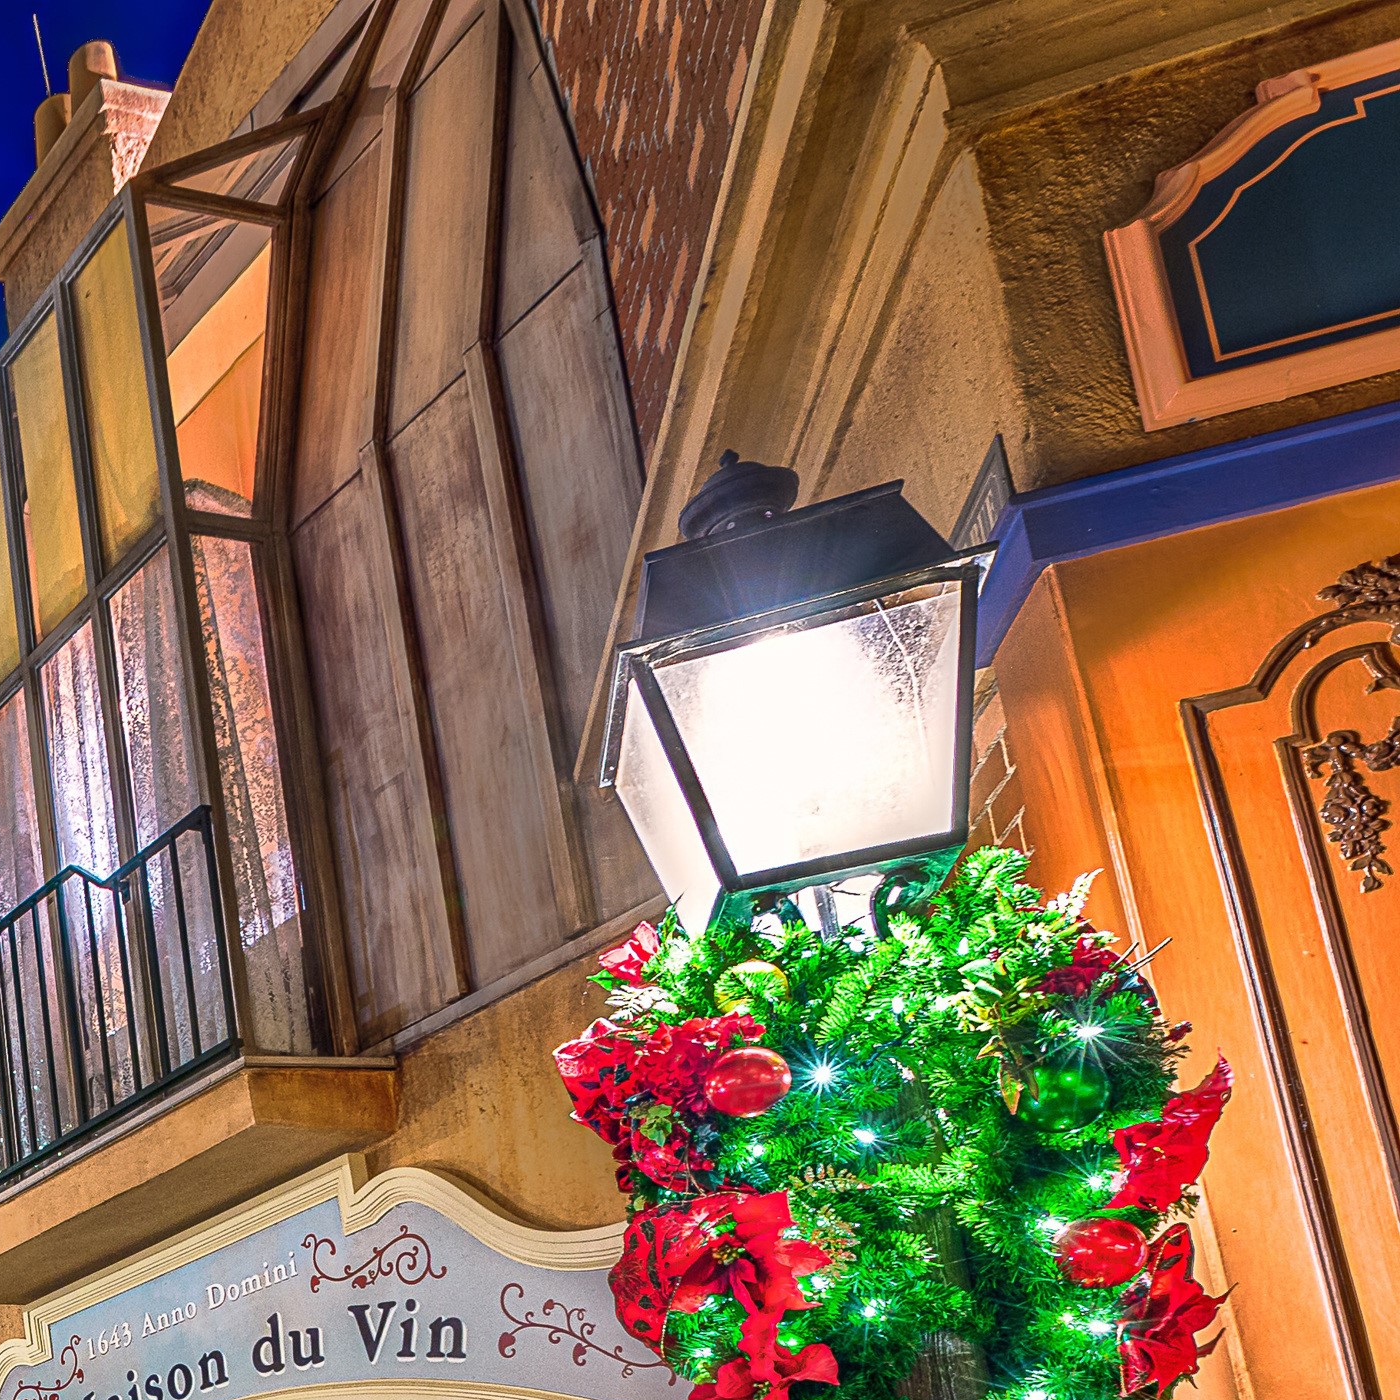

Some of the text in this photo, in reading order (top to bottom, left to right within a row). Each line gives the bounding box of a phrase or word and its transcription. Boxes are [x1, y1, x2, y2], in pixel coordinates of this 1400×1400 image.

[86, 1251, 299, 1361] 1643 Anno Domini
[251, 1311, 327, 1377] du
[347, 1298, 469, 1366] Vin
